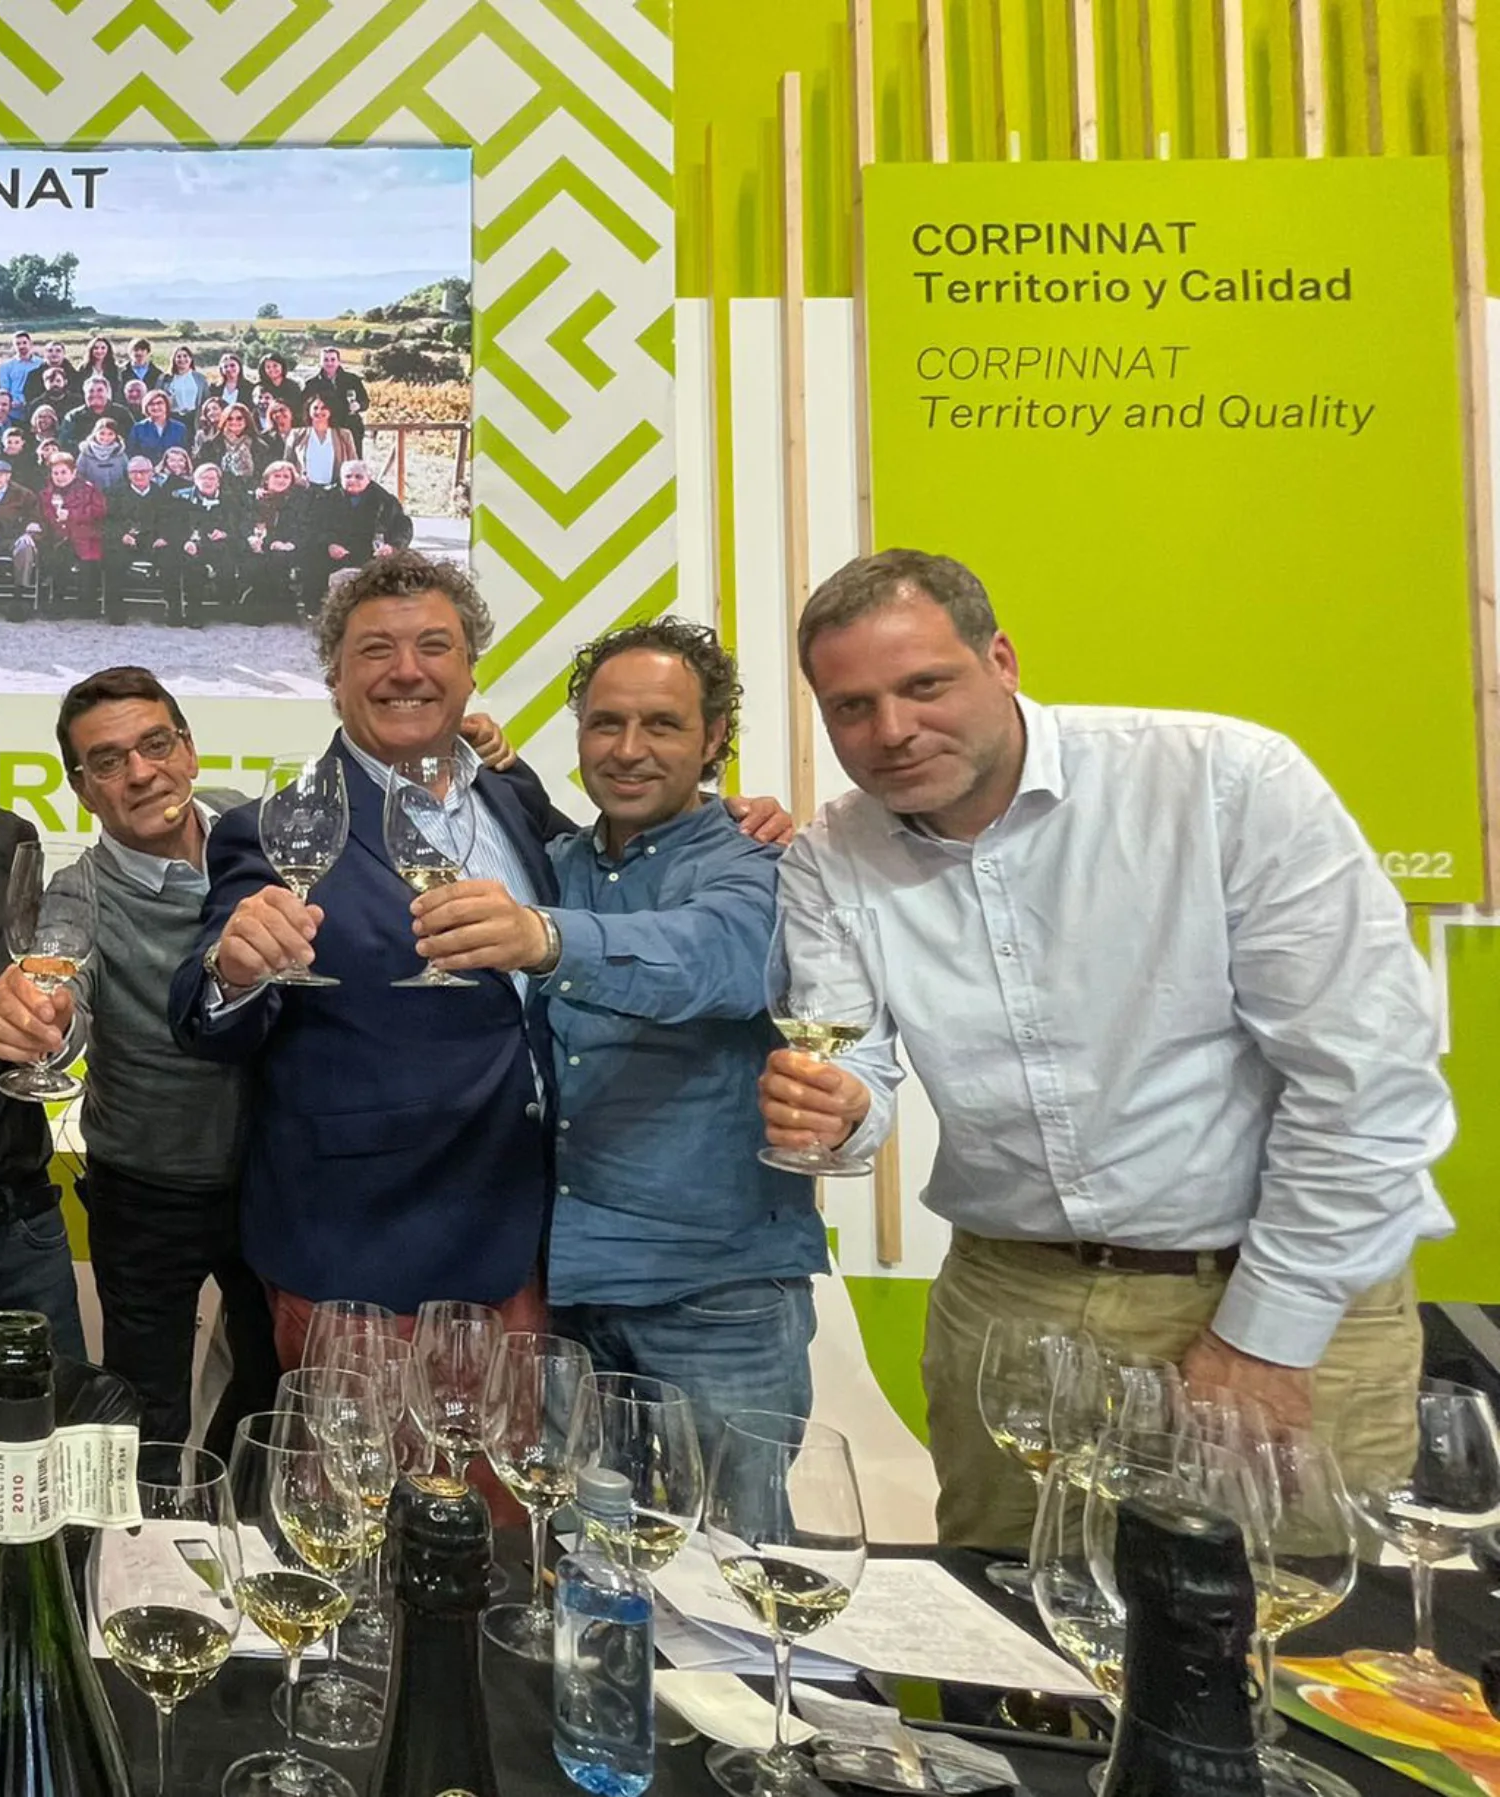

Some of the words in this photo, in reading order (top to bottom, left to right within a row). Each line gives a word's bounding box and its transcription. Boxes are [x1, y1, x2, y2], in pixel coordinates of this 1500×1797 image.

[912, 221, 1197, 257] CORPINNAT
[913, 271, 1131, 304] Territorio
[1143, 278, 1168, 309] y
[1180, 267, 1353, 303] Calidad
[916, 345, 1192, 381] CORPINNAT
[919, 395, 1112, 435] Territory
[1124, 395, 1206, 429] and
[1219, 394, 1376, 436] Quality
[1382, 851, 1453, 878] G22
[12, 1475, 24, 1513] 2010
